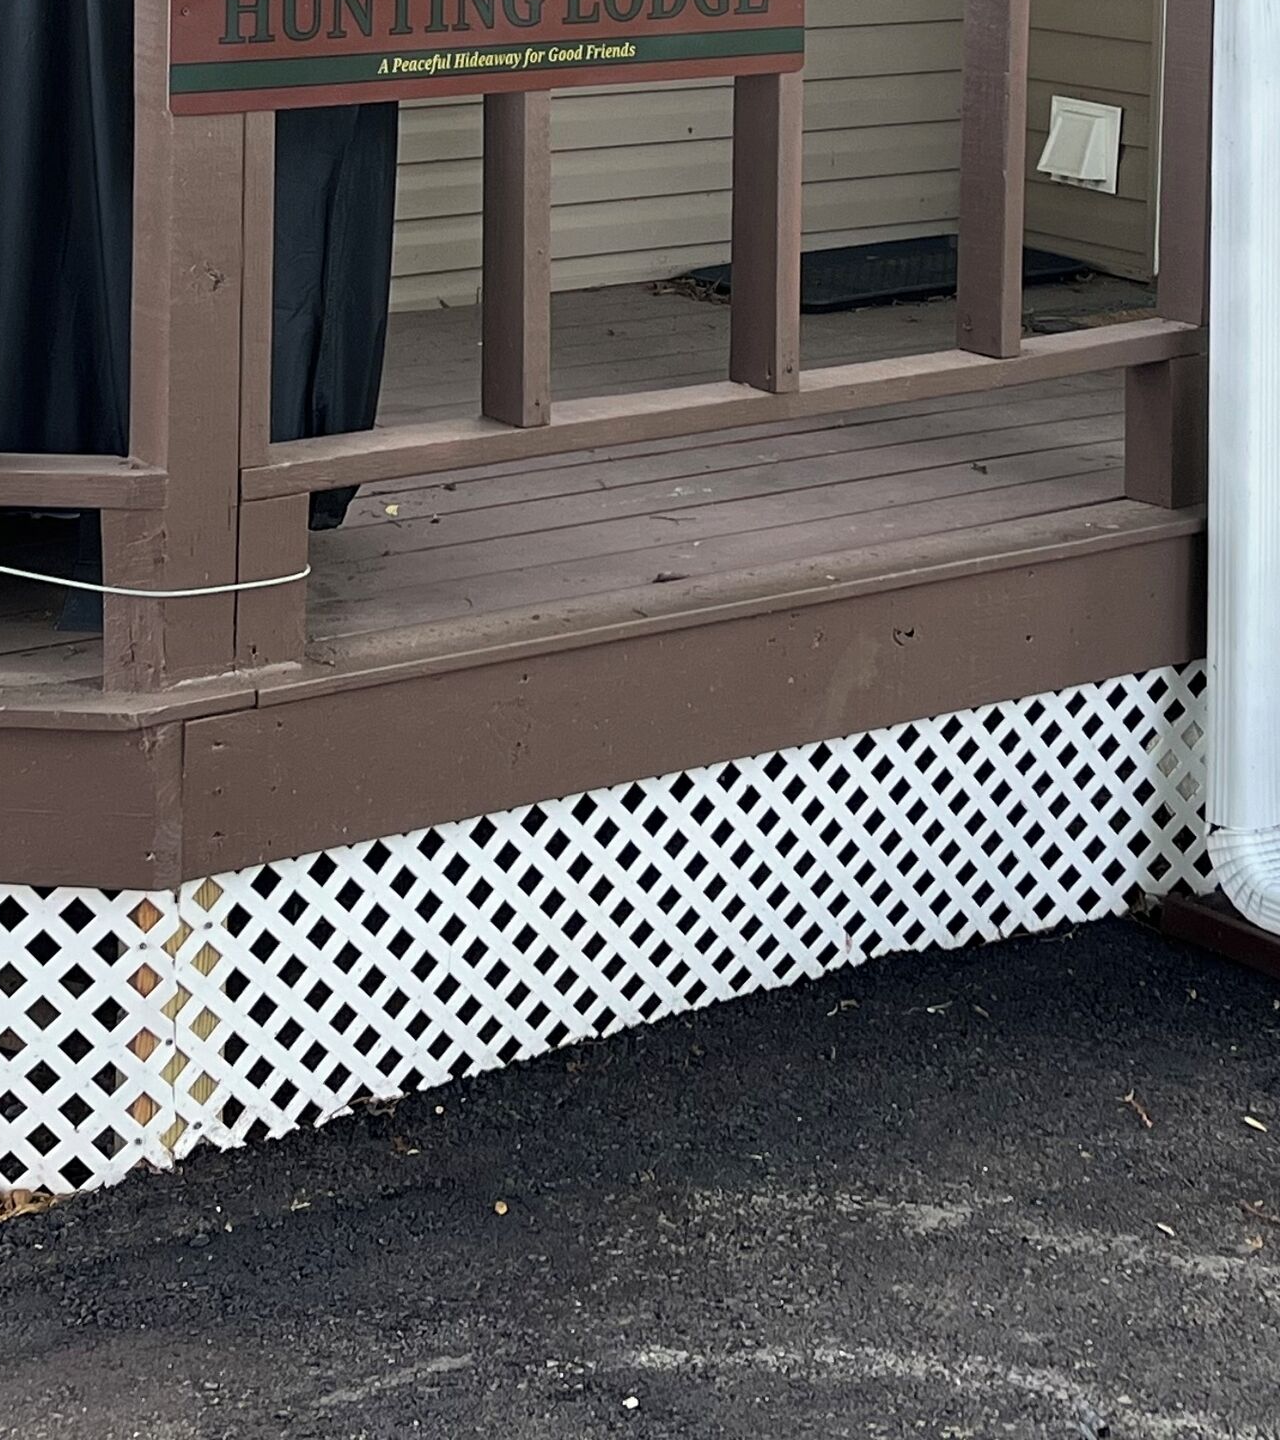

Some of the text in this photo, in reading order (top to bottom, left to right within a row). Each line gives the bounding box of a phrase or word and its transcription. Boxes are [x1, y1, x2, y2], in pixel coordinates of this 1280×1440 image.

[377, 42, 637, 75] A Peaceful Hideaway for Good Friends
